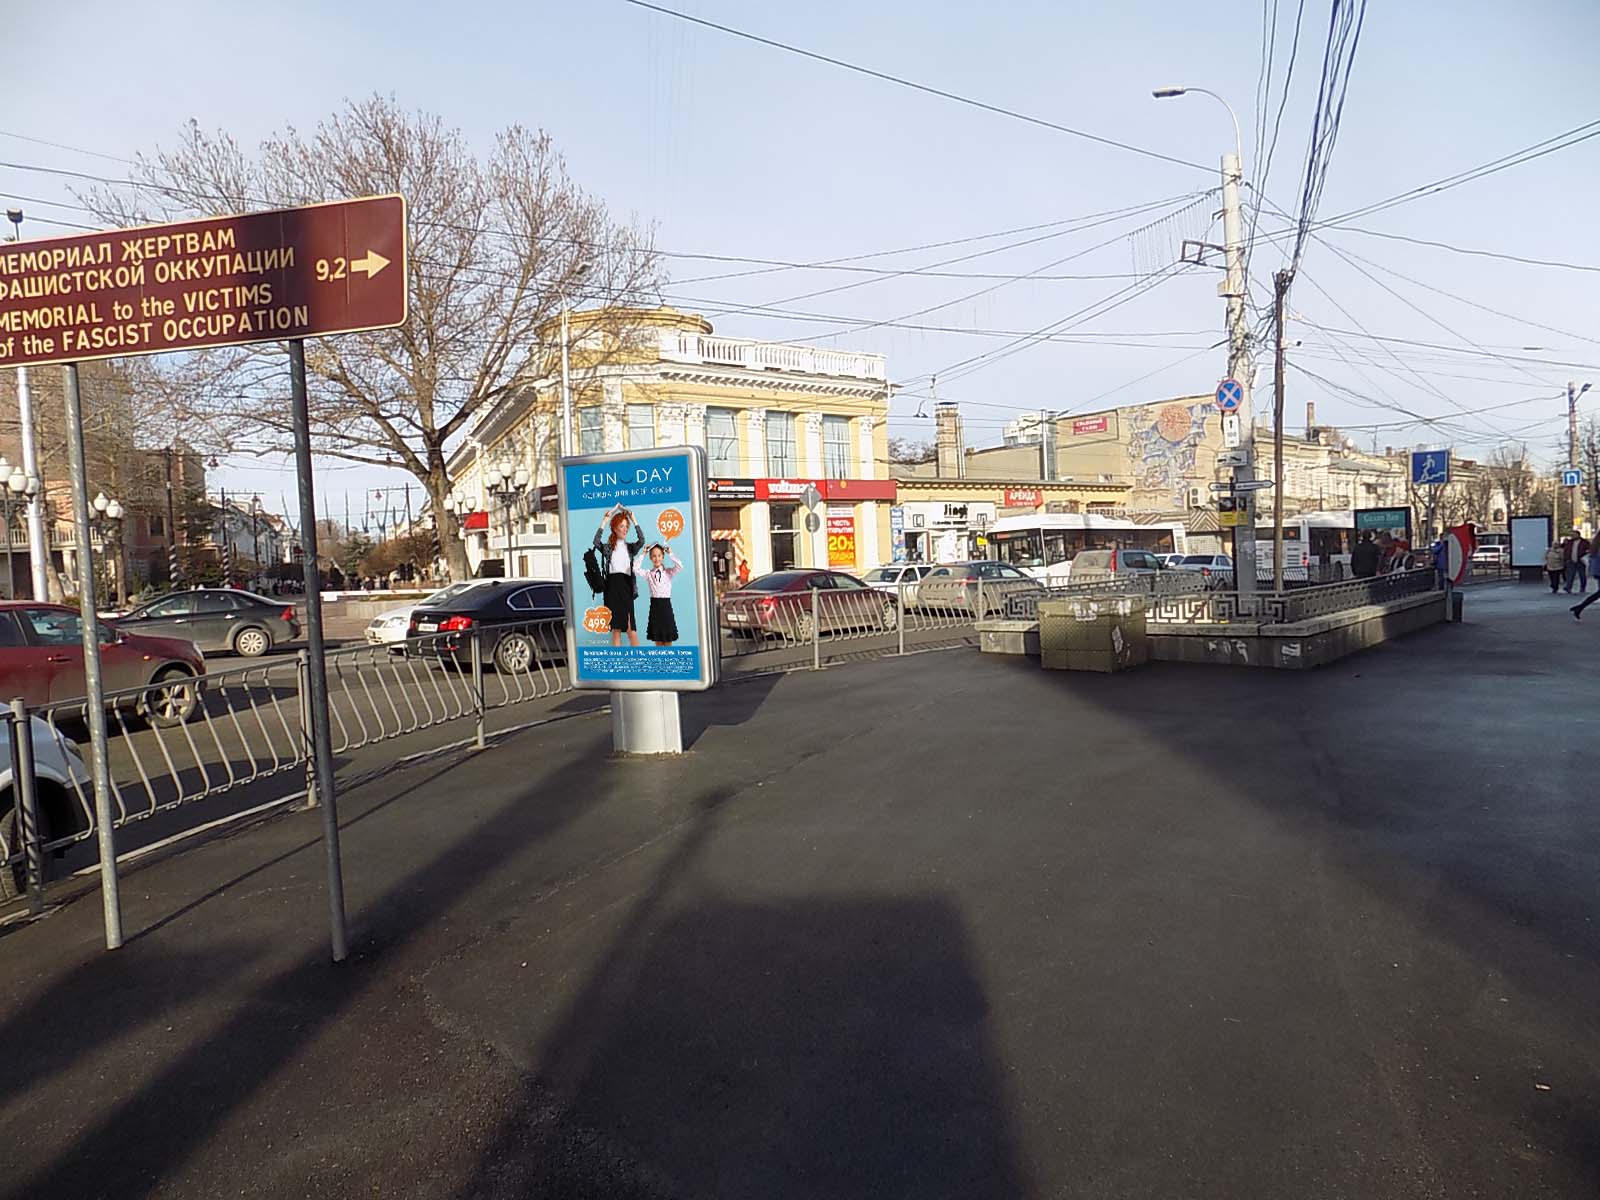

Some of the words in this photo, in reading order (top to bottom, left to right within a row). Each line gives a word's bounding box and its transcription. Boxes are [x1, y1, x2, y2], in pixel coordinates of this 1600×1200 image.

[121, 228, 236, 262] ЖЕРТВАМ
[154, 246, 295, 283] ОККУПАЦИИ
[315, 257, 347, 282] 9,2
[113, 301, 133, 321] to
[141, 295, 175, 318] the
[183, 283, 273, 313] VICTIMS
[23, 334, 55, 356] the
[62, 322, 153, 351] FASCIST
[163, 305, 309, 342] OCCUPATION
[581, 471, 618, 488] FUN
[636, 466, 673, 484] DAY
